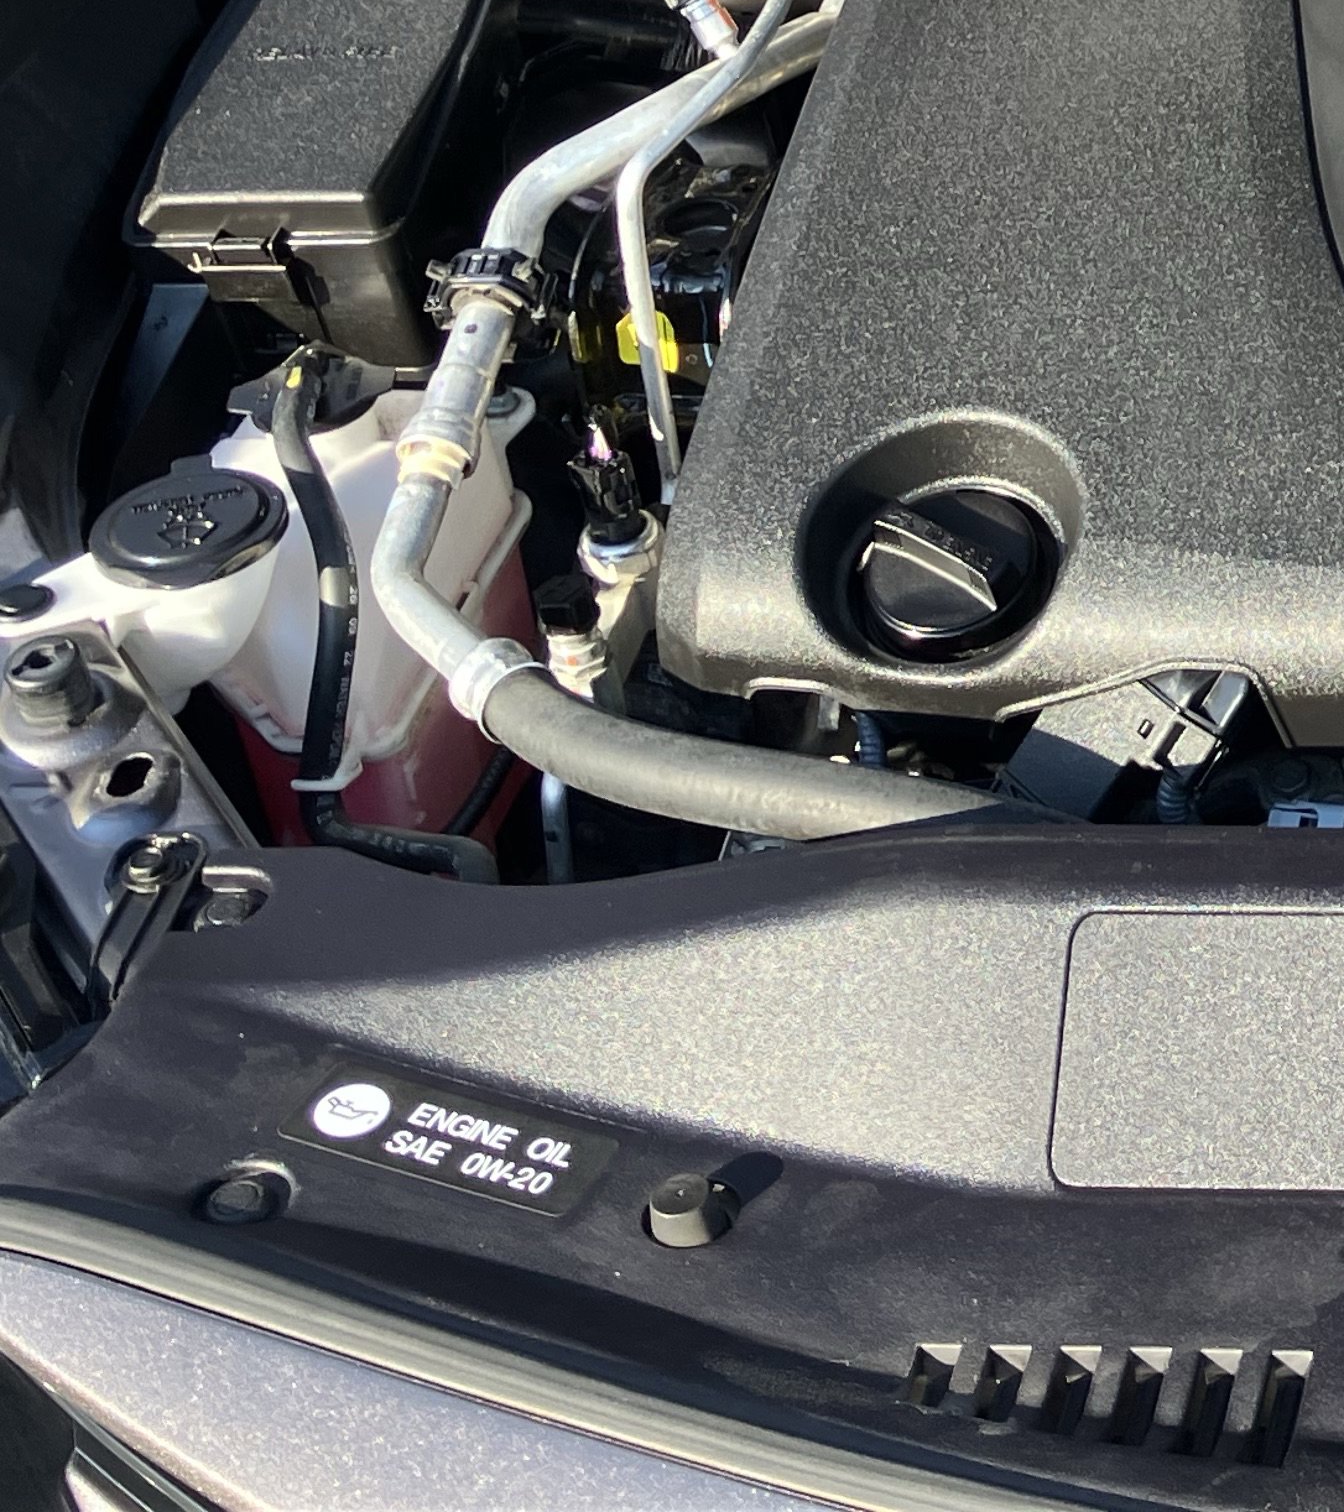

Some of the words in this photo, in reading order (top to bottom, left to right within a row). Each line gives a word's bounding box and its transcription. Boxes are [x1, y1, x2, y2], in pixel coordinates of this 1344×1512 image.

[384, 1130, 452, 1165] SAE
[459, 1151, 554, 1195] 0W-20
[407, 1102, 519, 1150] ENGINE
[526, 1136, 573, 1168] OIL
